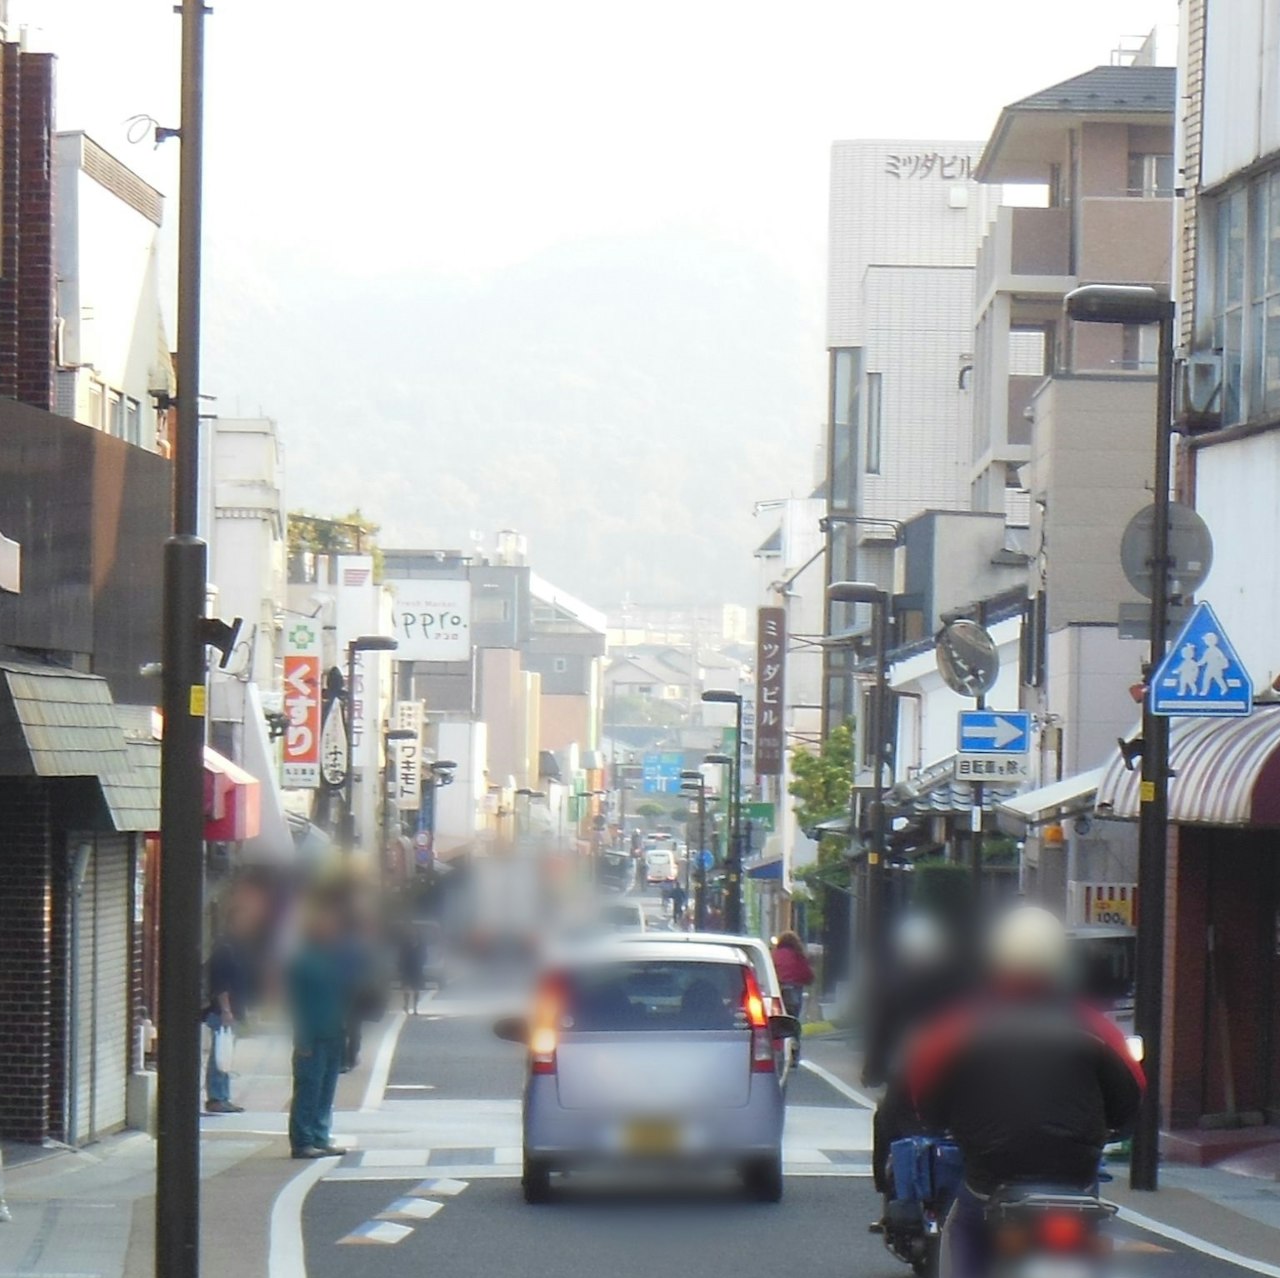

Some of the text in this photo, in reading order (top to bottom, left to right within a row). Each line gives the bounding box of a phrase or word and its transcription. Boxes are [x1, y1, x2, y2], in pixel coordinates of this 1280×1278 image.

[884, 152, 974, 180] ミツダビル
[762, 620, 781, 727] ミツダビル
[286, 663, 318, 756] くすり
[400, 745, 417, 798] ワキモト
[960, 760, 1027, 776] 自転車を除く
